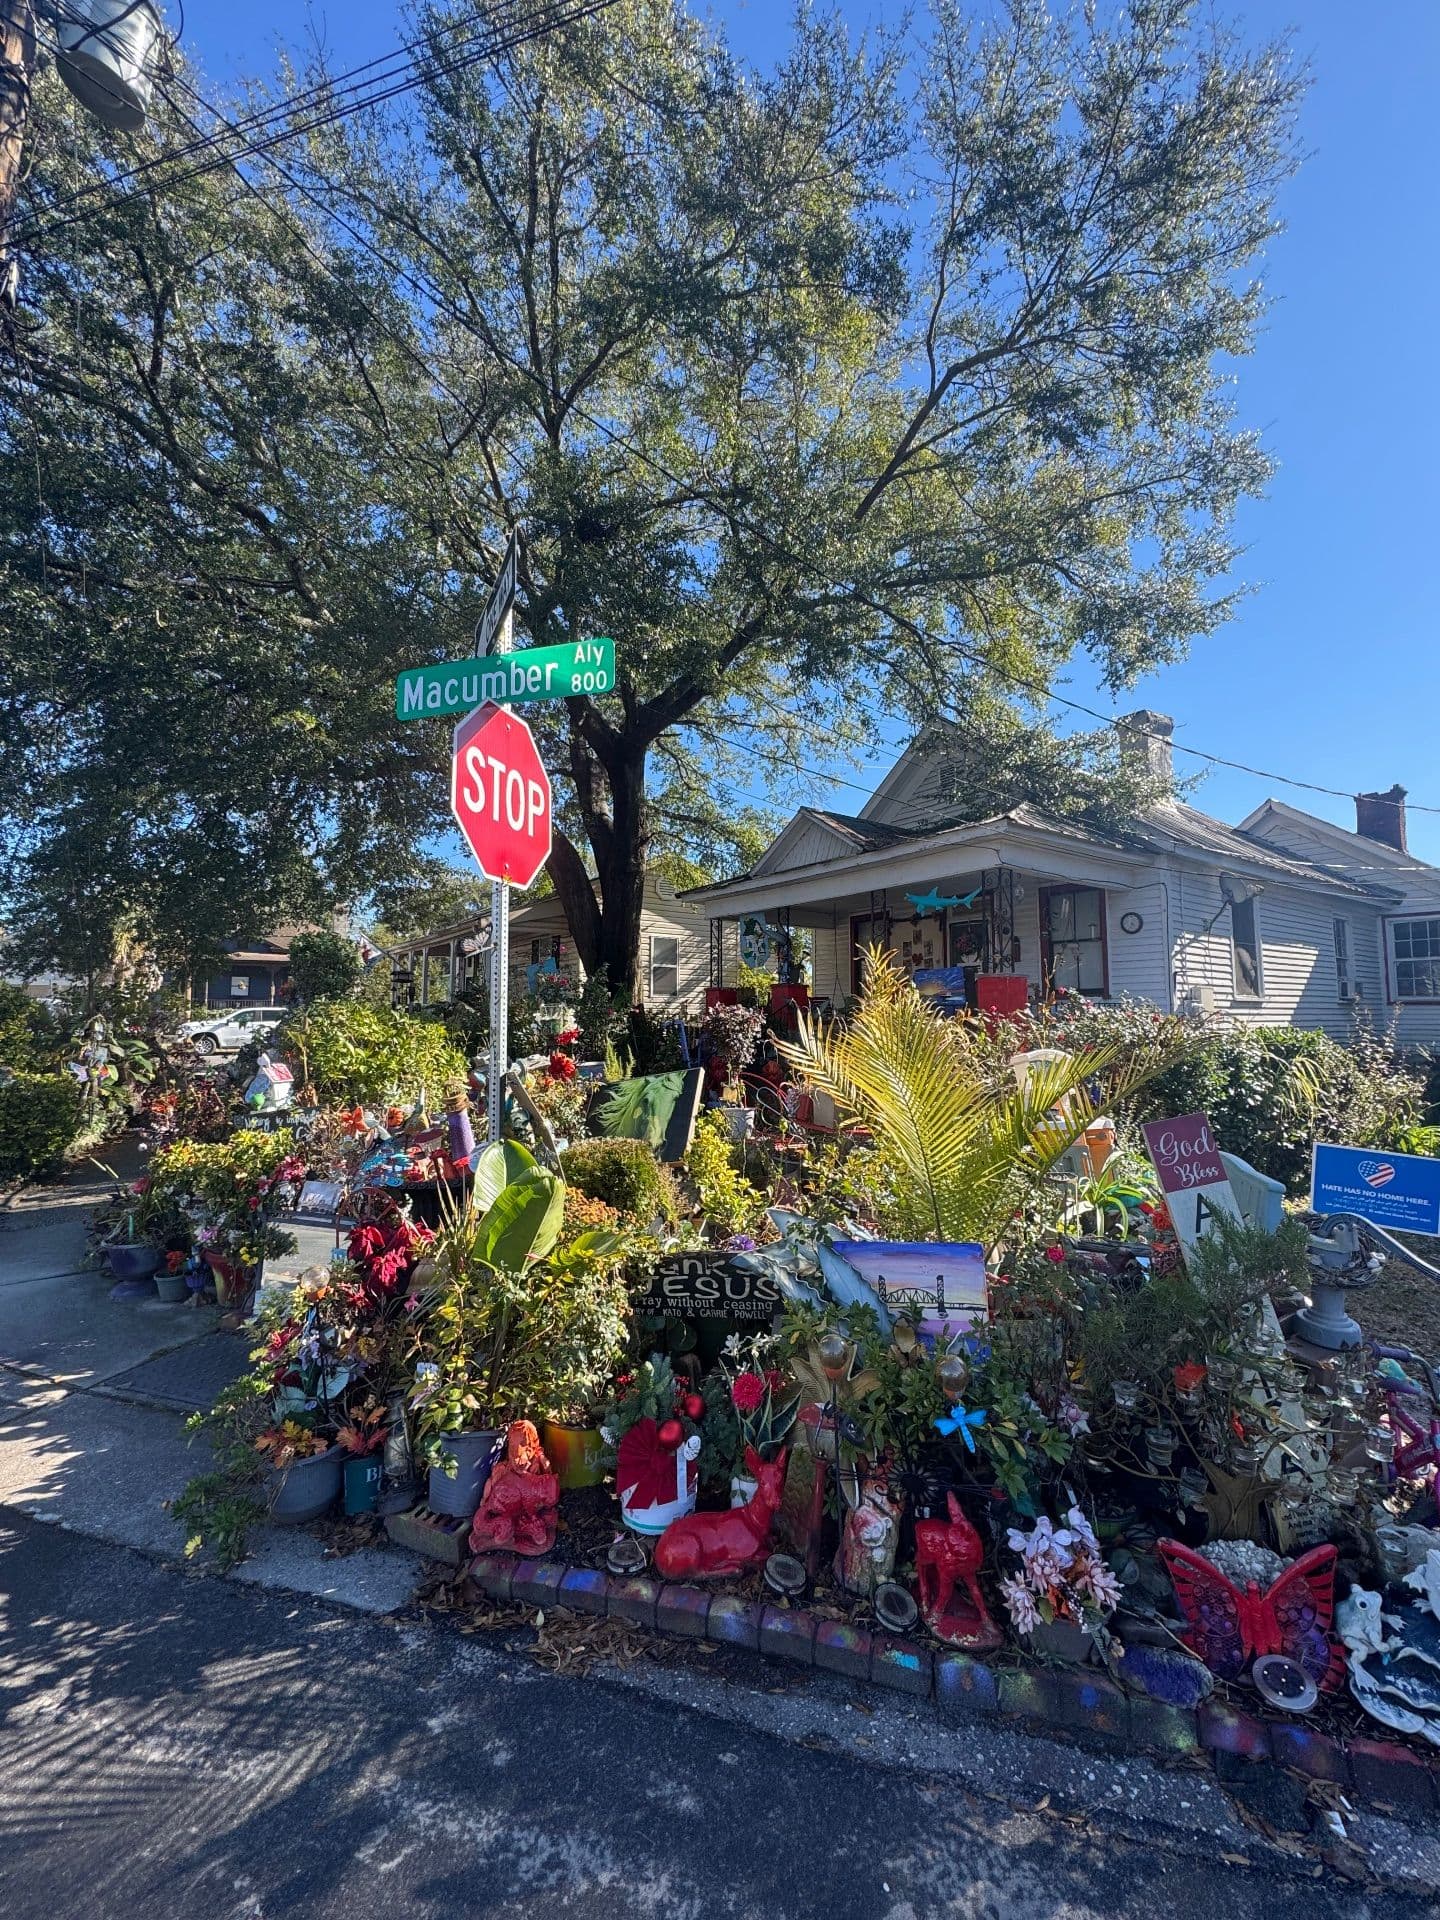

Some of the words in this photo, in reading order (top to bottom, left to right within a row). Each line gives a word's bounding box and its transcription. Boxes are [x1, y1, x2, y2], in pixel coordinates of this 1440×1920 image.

[403, 661, 558, 713] Macumber
[574, 644, 605, 666] Aly
[571, 670, 608, 693] 800
[463, 745, 545, 838] STOP
[1153, 1126, 1216, 1166] God
[1173, 1162, 1219, 1187] Bless
[1321, 1183, 1343, 1193] HATE
[1343, 1187, 1361, 1196] HAS
[1361, 1190, 1377, 1198] NO
[1377, 1192, 1405, 1202] HOME
[659, 1257, 729, 1278] ank
[642, 1275, 780, 1301] JESUS
[662, 1308, 682, 1318] KATO
[686, 1307, 696, 1318] &
[734, 1310, 767, 1320] POWELL
[667, 1296, 715, 1309] without
[723, 1299, 774, 1313] ceasing
